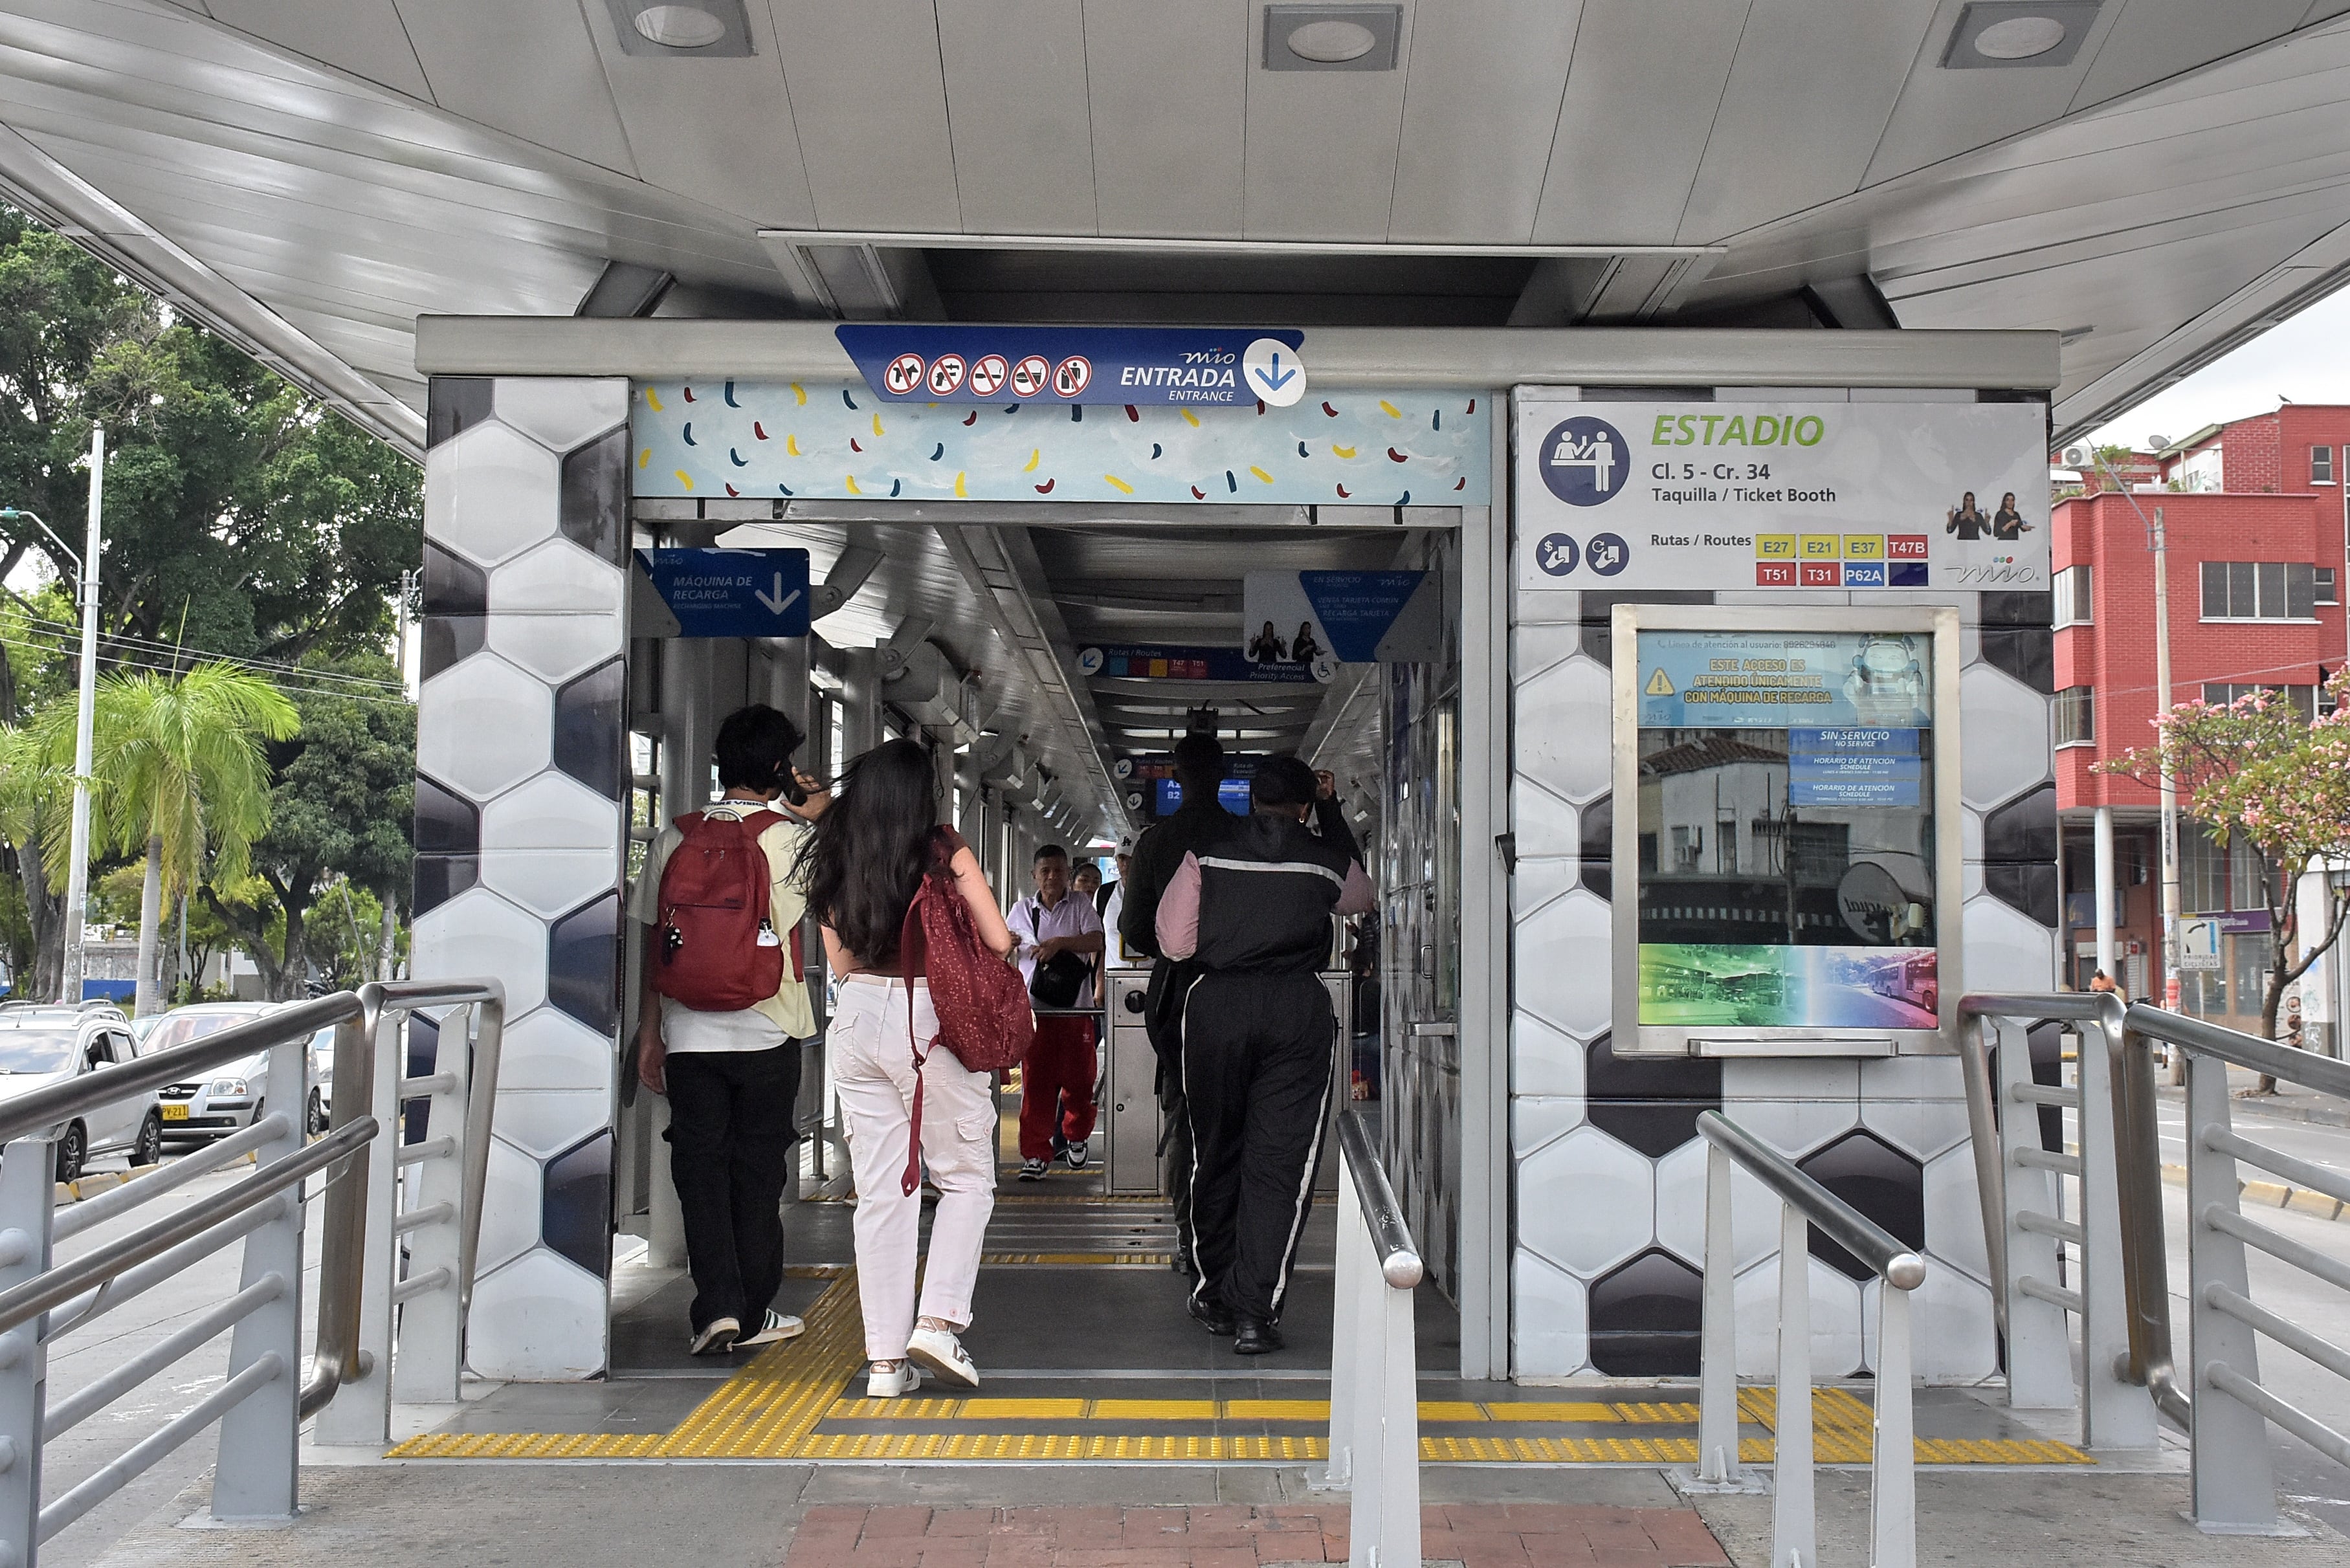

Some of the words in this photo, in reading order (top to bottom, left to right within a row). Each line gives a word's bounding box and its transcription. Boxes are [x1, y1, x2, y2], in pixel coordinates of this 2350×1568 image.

[1120, 367, 1236, 388] ENTRADA
[1168, 390, 1234, 401] ENTRANCE
[1651, 414, 1825, 447] ESTADIO
[1652, 463, 1676, 480] Cl.
[1683, 464, 1694, 480] 5
[1713, 463, 1740, 480] Cr.
[1747, 464, 1771, 480] 34
[1652, 488, 1717, 505] Taquilla
[1733, 488, 1782, 502] Ticket
[1788, 488, 1836, 502] Booth
[1651, 534, 1690, 546] Rutas
[1703, 534, 1751, 546] Routes
[1764, 542, 1789, 553] E27
[1807, 542, 1832, 553] E21
[1851, 542, 1876, 553] E37
[1889, 542, 1926, 554] T47B
[673, 575, 733, 588] MÁQUINA
[737, 576, 753, 586] DE
[1763, 569, 1788, 581] T51
[1807, 569, 1832, 581] T31
[1846, 569, 1883, 582] P62A
[673, 590, 729, 600] RECARGA
[1704, 640, 1738, 648] atención
[1258, 663, 1305, 672] Preferencial
[1709, 659, 1739, 672] ESTE
[1742, 659, 1786, 672] ACCESO
[1790, 659, 1806, 672] ES
[1250, 672, 1278, 681] Priority
[1693, 675, 1749, 687] ATENDIDO
[1750, 672, 1823, 688] ÚNICAMENTE
[1685, 691, 1709, 703] CON
[1710, 689, 1760, 705] MÁQUINA
[1763, 691, 1779, 703] DE
[1780, 692, 1833, 704] RECARGA
[1820, 731, 1838, 740] SIN
[1840, 731, 1890, 740] SERVICIO
